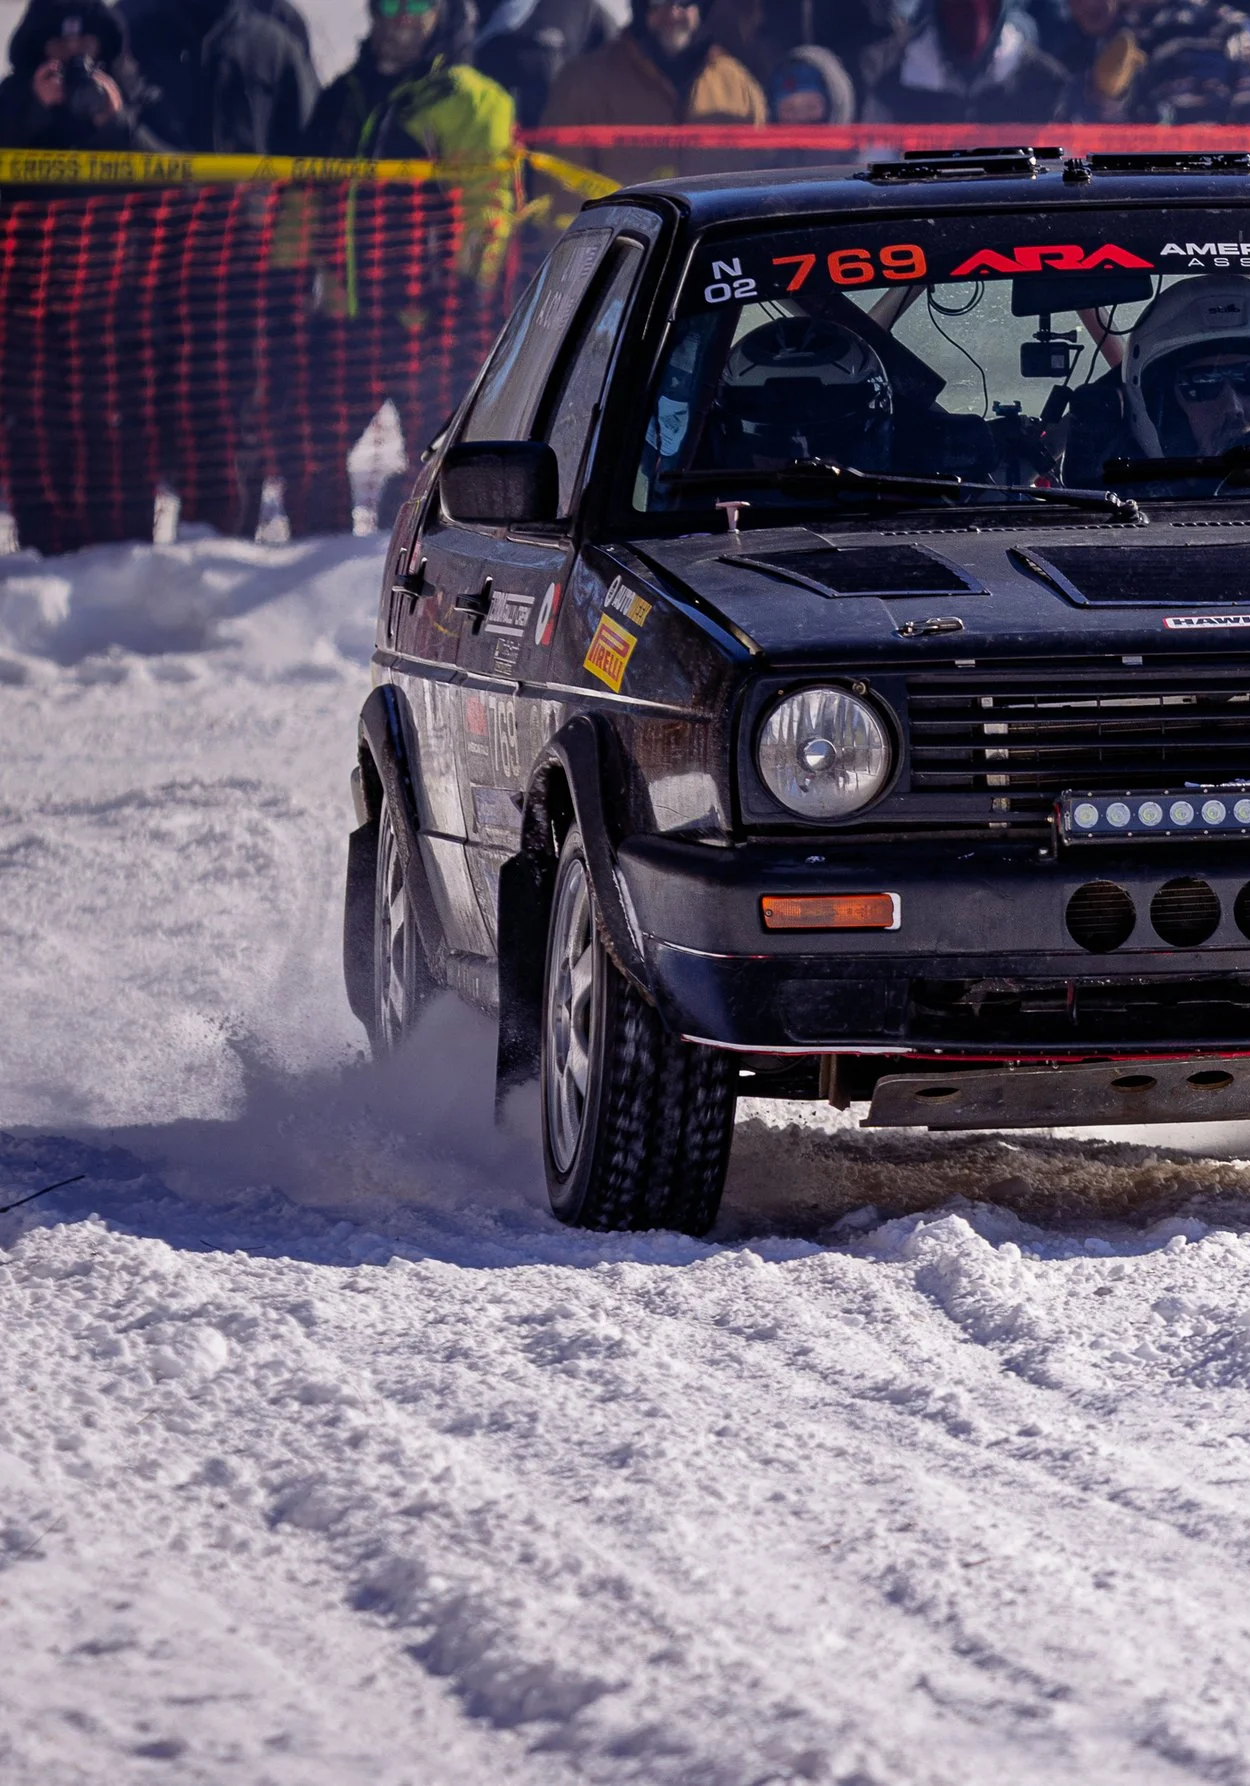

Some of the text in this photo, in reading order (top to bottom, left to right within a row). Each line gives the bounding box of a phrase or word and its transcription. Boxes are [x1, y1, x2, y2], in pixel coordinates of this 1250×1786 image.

[711, 257, 743, 279] N
[772, 244, 927, 292] 769
[949, 244, 1155, 276] ARA
[704, 278, 758, 304] 02
[588, 623, 630, 682] PIRELLI
[489, 696, 521, 777] 769
